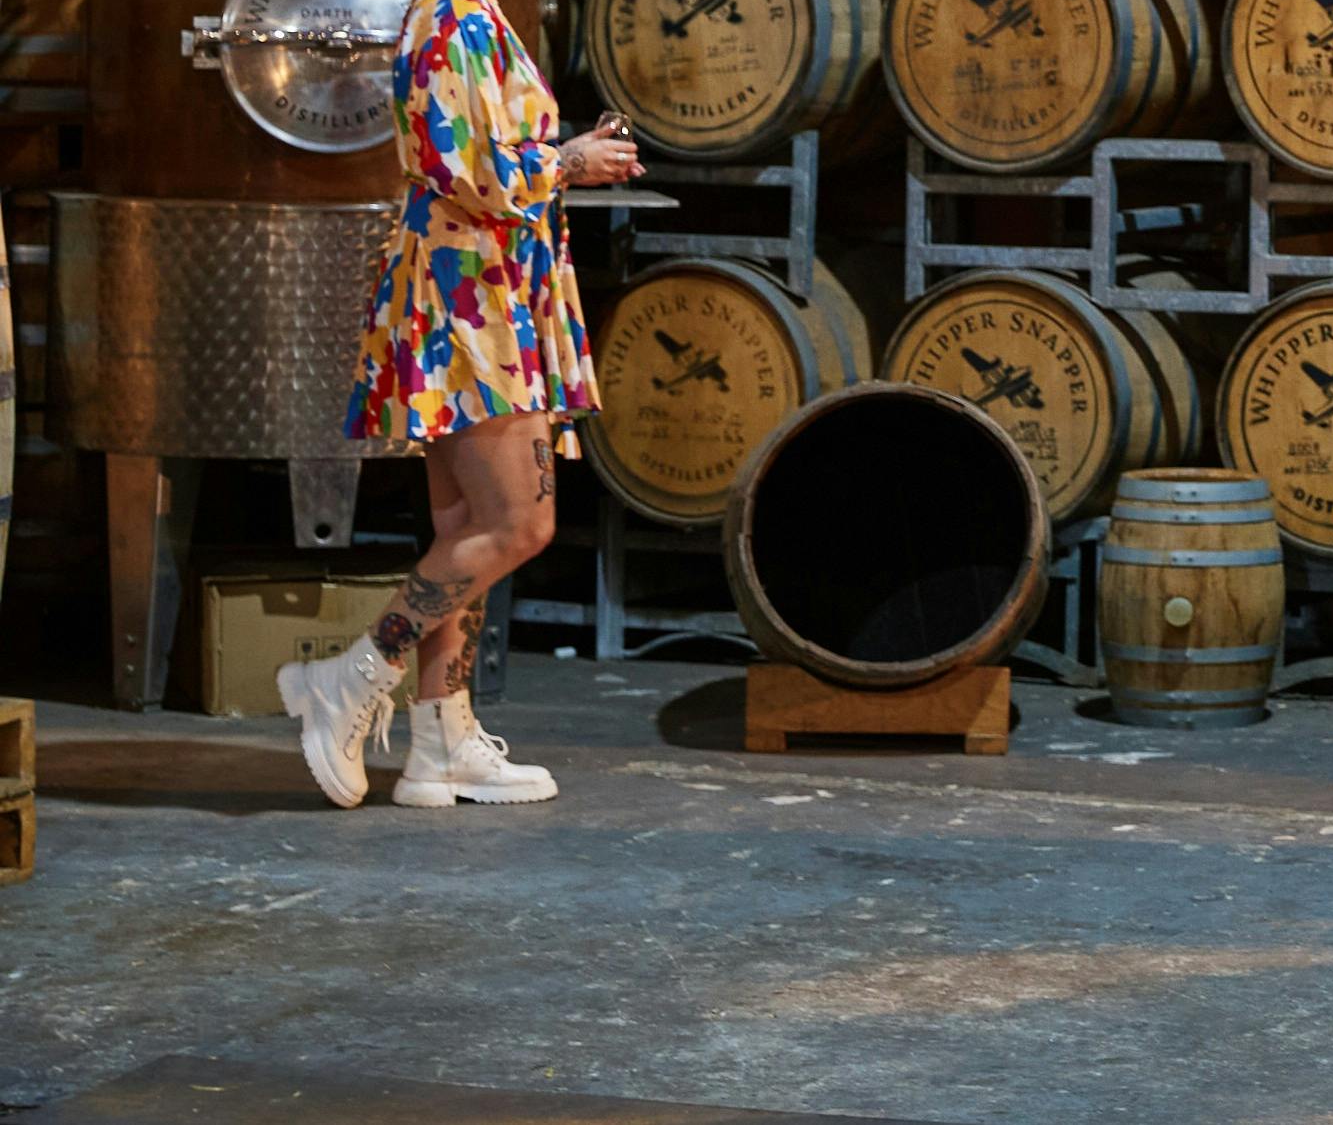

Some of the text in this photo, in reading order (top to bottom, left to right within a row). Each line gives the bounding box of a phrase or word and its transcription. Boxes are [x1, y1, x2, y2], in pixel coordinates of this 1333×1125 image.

[301, 8, 353, 19] DARTH
[276, 97, 391, 128] DISTILLERY
[703, 302, 774, 400] SNAPPER
[913, 313, 1089, 416] HIPPER SNAPPER
